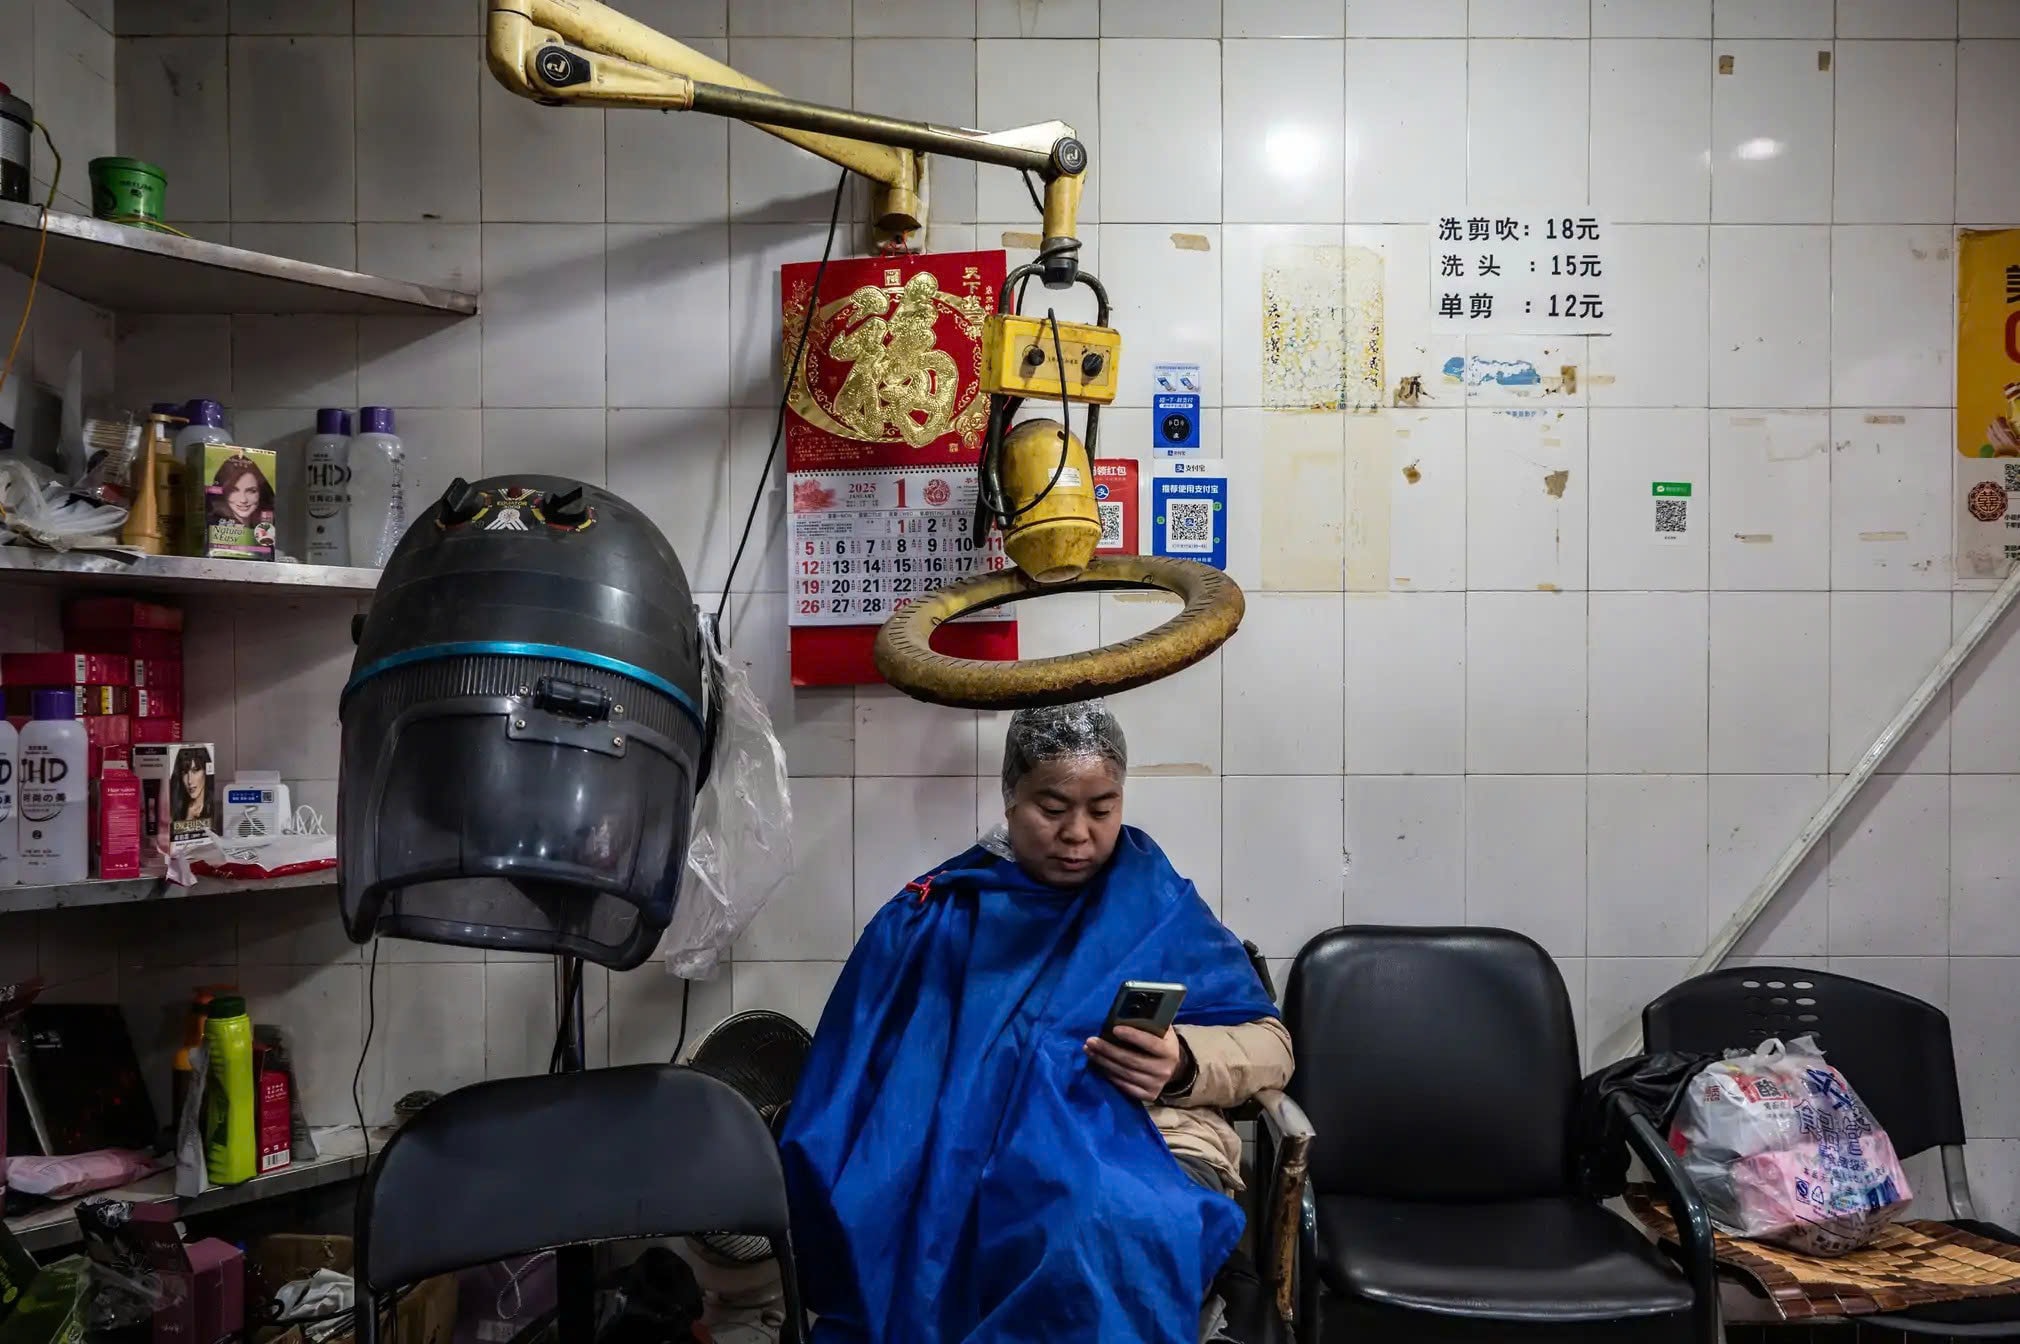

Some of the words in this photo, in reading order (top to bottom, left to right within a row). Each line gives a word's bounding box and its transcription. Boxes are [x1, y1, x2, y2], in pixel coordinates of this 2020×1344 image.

[1546, 217, 1600, 241] 18元
[1551, 254, 1602, 277] 15元
[1438, 292, 1494, 319] 单剪
[1548, 294, 1603, 319] 12元
[1185, 464, 1206, 472] 支付宝
[848, 483, 877, 493] 2025
[893, 477, 909, 508] 1
[897, 519, 905, 534] 1
[927, 518, 937, 532] 2
[958, 517, 968, 532] 3
[805, 541, 815, 556] 5
[836, 540, 846, 555] 6
[866, 539, 875, 554] 7
[897, 538, 907, 553] 8
[927, 538, 937, 552] 9
[955, 537, 973, 551] 10
[986, 536, 1003, 551] 11
[802, 560, 820, 575] 12
[832, 559, 850, 574] 13
[863, 559, 881, 573] 14
[893, 558, 912, 573] 15
[924, 557, 943, 572] 16
[955, 557, 973, 571] 17
[986, 556, 1004, 571] 18
[802, 580, 820, 595] 19
[831, 579, 850, 594] 20
[862, 579, 880, 593] 21
[893, 578, 912, 593] 22
[923, 577, 942, 592] 23
[801, 599, 820, 614] 26
[831, 598, 850, 613] 27
[862, 598, 882, 613] 28
